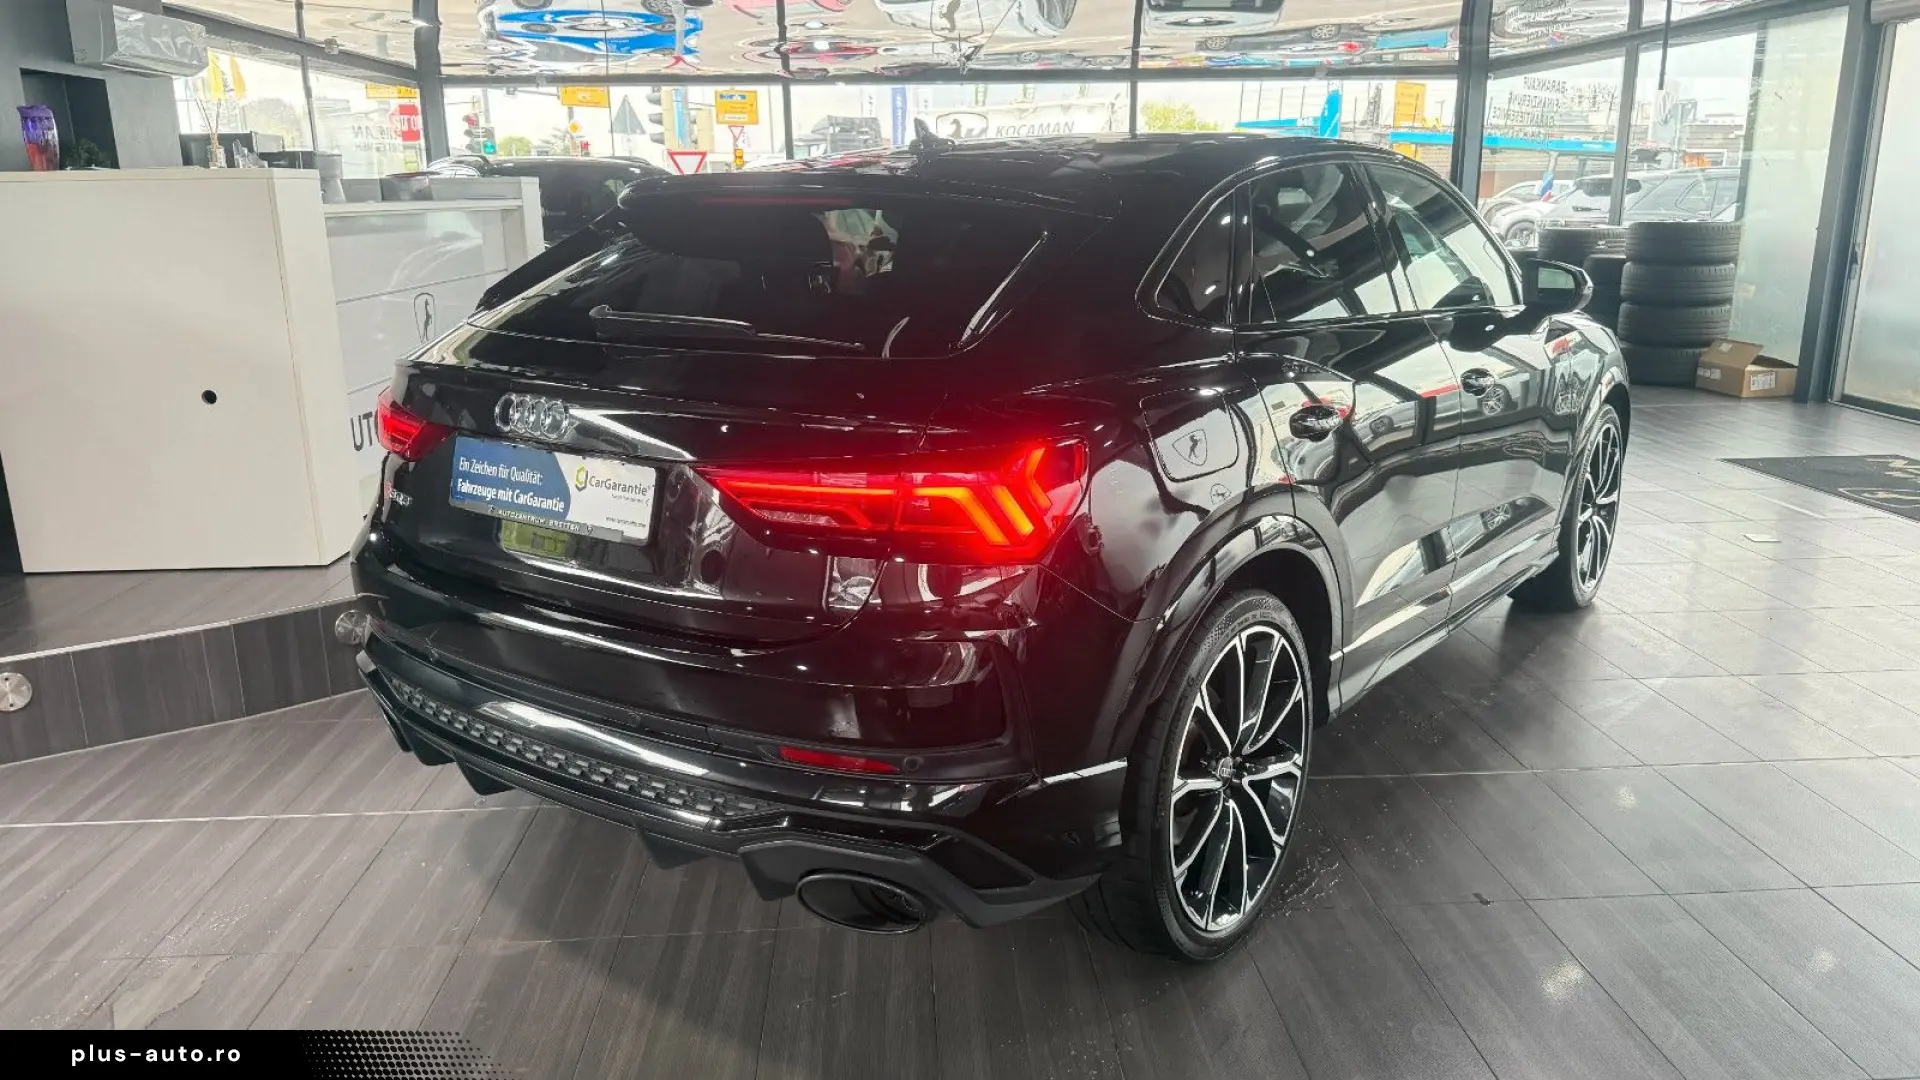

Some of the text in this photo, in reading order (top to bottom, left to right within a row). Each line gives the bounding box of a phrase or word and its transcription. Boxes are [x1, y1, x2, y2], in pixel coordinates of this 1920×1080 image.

[995, 121, 1075, 138] KOCAMAN
[458, 456, 543, 486] Ein Zeichen für Qualität:
[457, 478, 565, 512] Fahrzeuge mit CarGarantie
